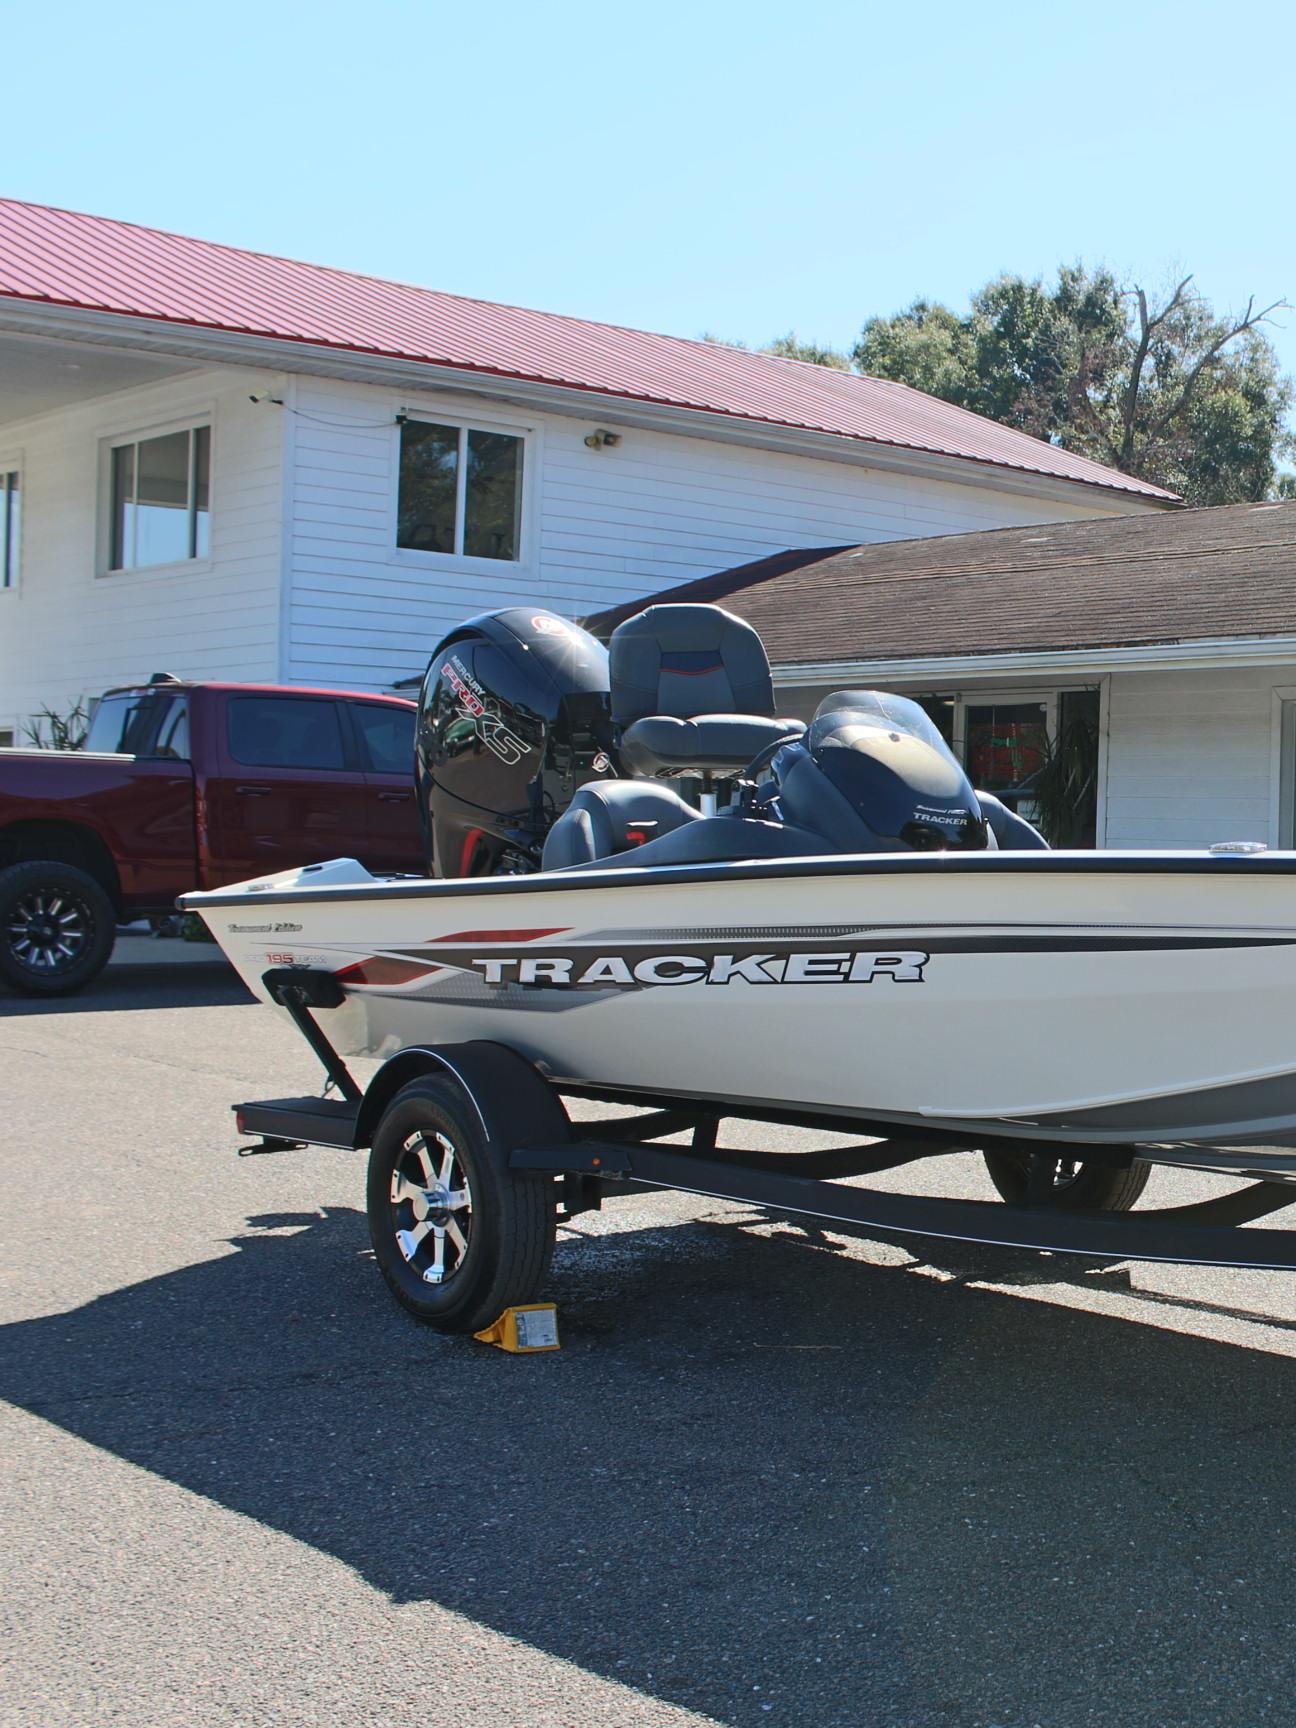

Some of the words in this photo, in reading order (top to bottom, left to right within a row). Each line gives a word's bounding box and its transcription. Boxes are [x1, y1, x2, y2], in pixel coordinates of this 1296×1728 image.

[441, 663, 485, 717] PRO
[451, 655, 486, 696] MERCURY
[455, 706, 532, 765] XS
[912, 812, 968, 826] TRACKER
[265, 952, 294, 964] 195
[472, 950, 930, 985] TRACKER
